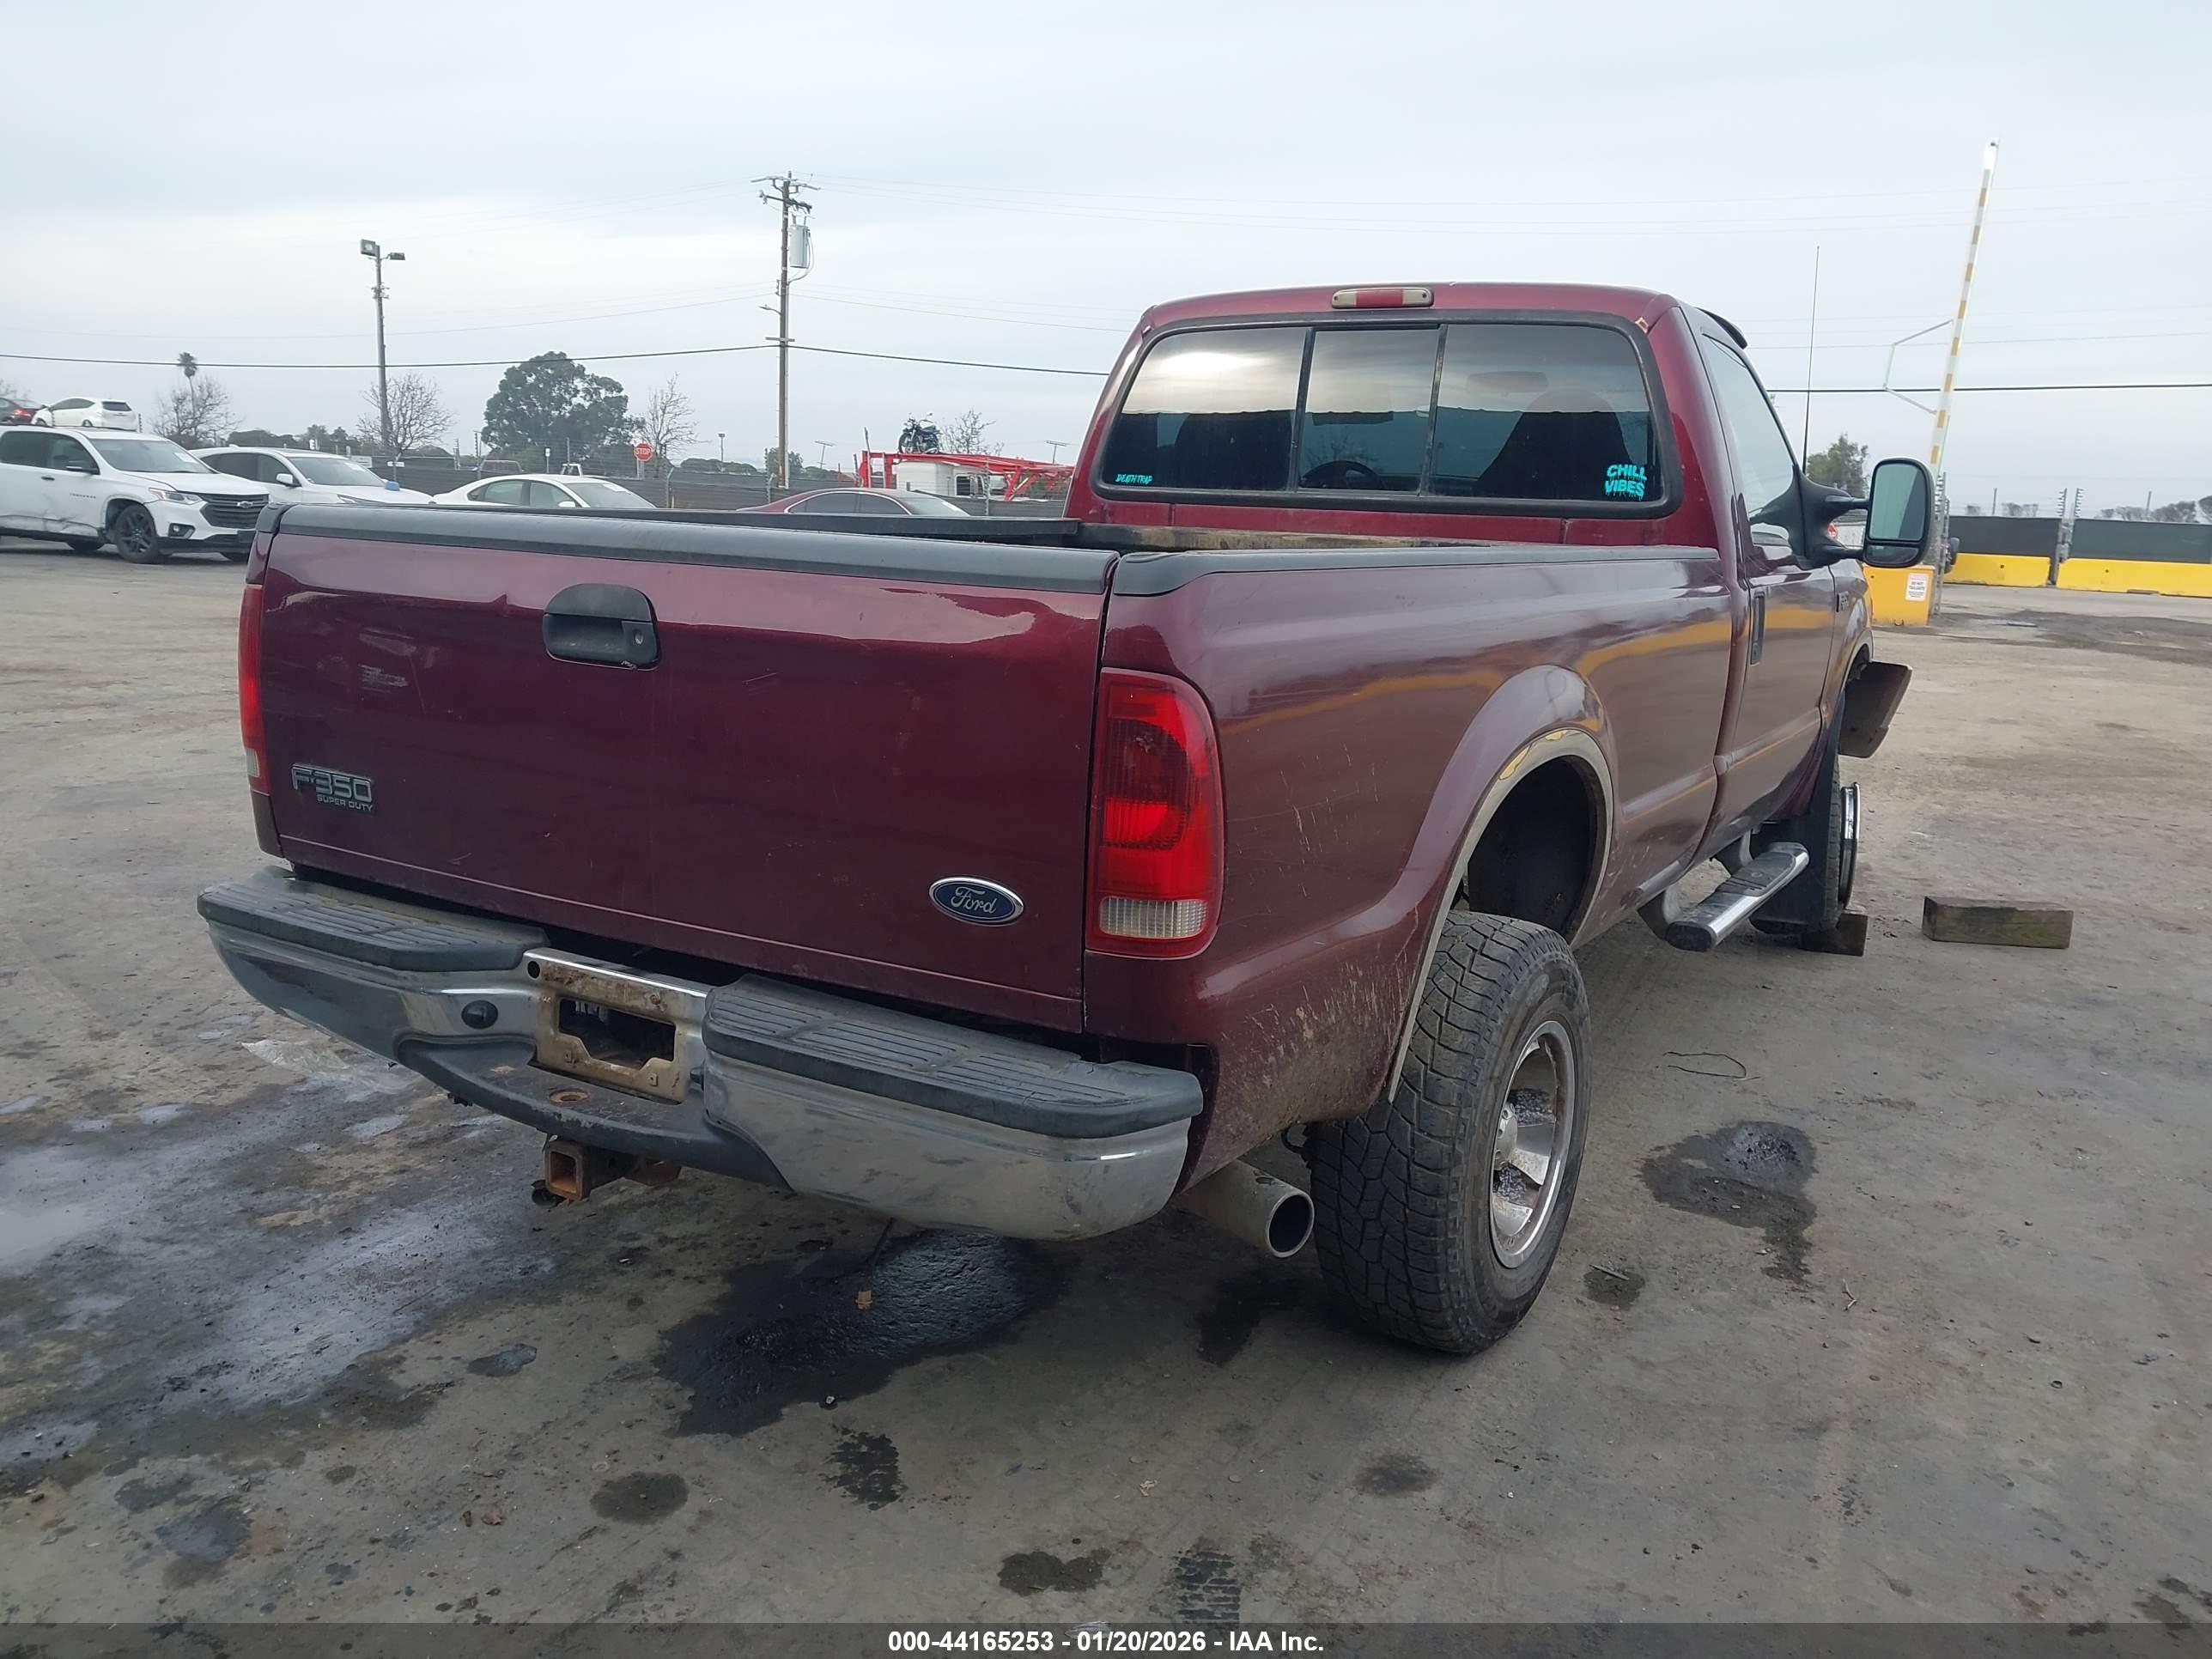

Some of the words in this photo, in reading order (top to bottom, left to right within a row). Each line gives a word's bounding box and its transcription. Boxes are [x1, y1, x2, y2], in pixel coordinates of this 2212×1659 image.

[1607, 464, 1648, 481] CHILL
[1605, 479, 1645, 501] VIBES
[316, 793, 347, 807] SUPER
[348, 800, 374, 811] DUTY
[951, 886, 998, 914] Ford
